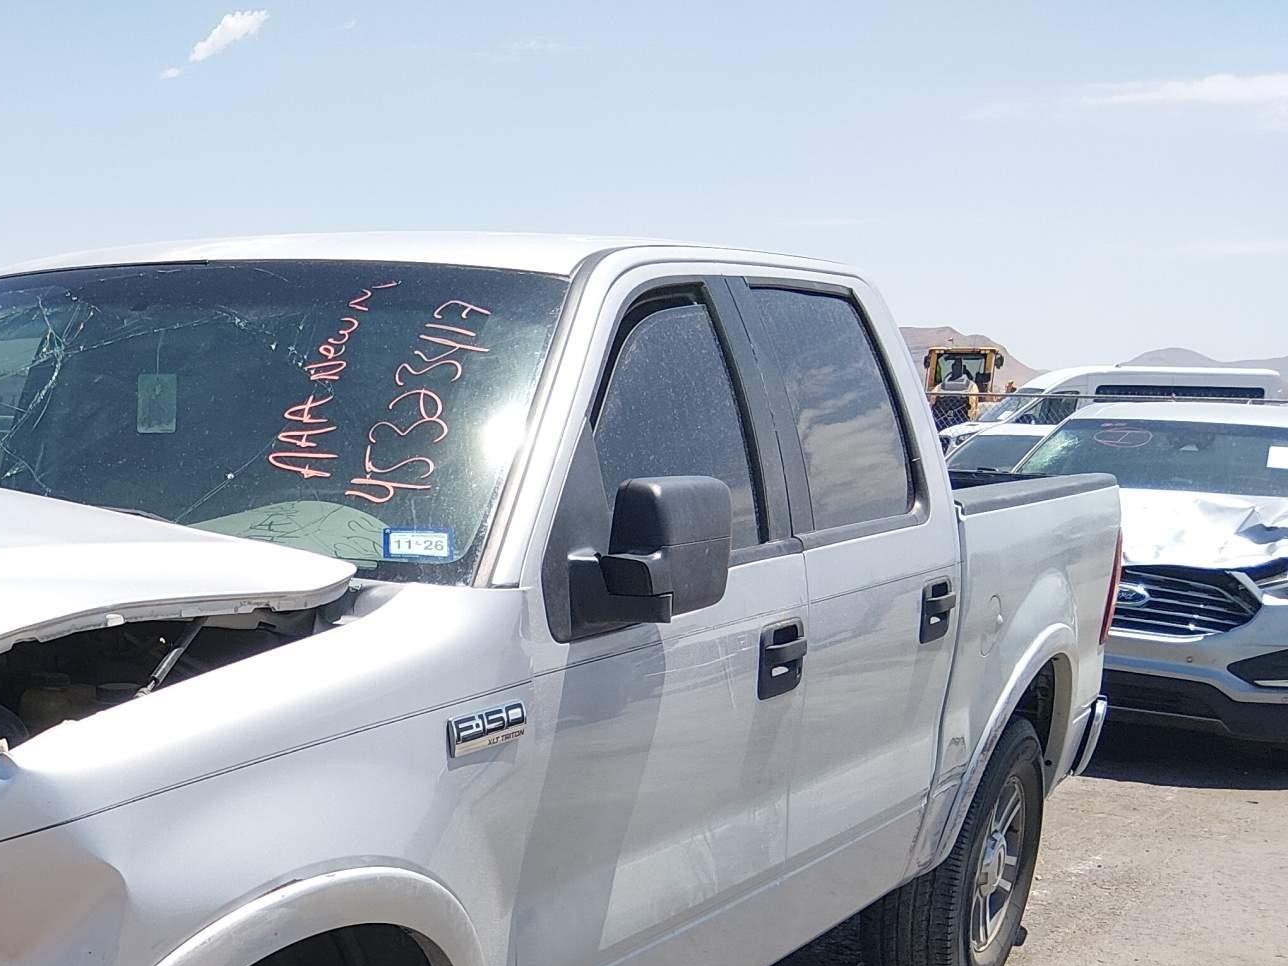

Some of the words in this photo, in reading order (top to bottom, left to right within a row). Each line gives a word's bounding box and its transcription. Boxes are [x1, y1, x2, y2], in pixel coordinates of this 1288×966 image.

[268, 394, 339, 479] AAA
[344, 299, 491, 504] 45323417
[500, 728, 525, 743] TRITON
